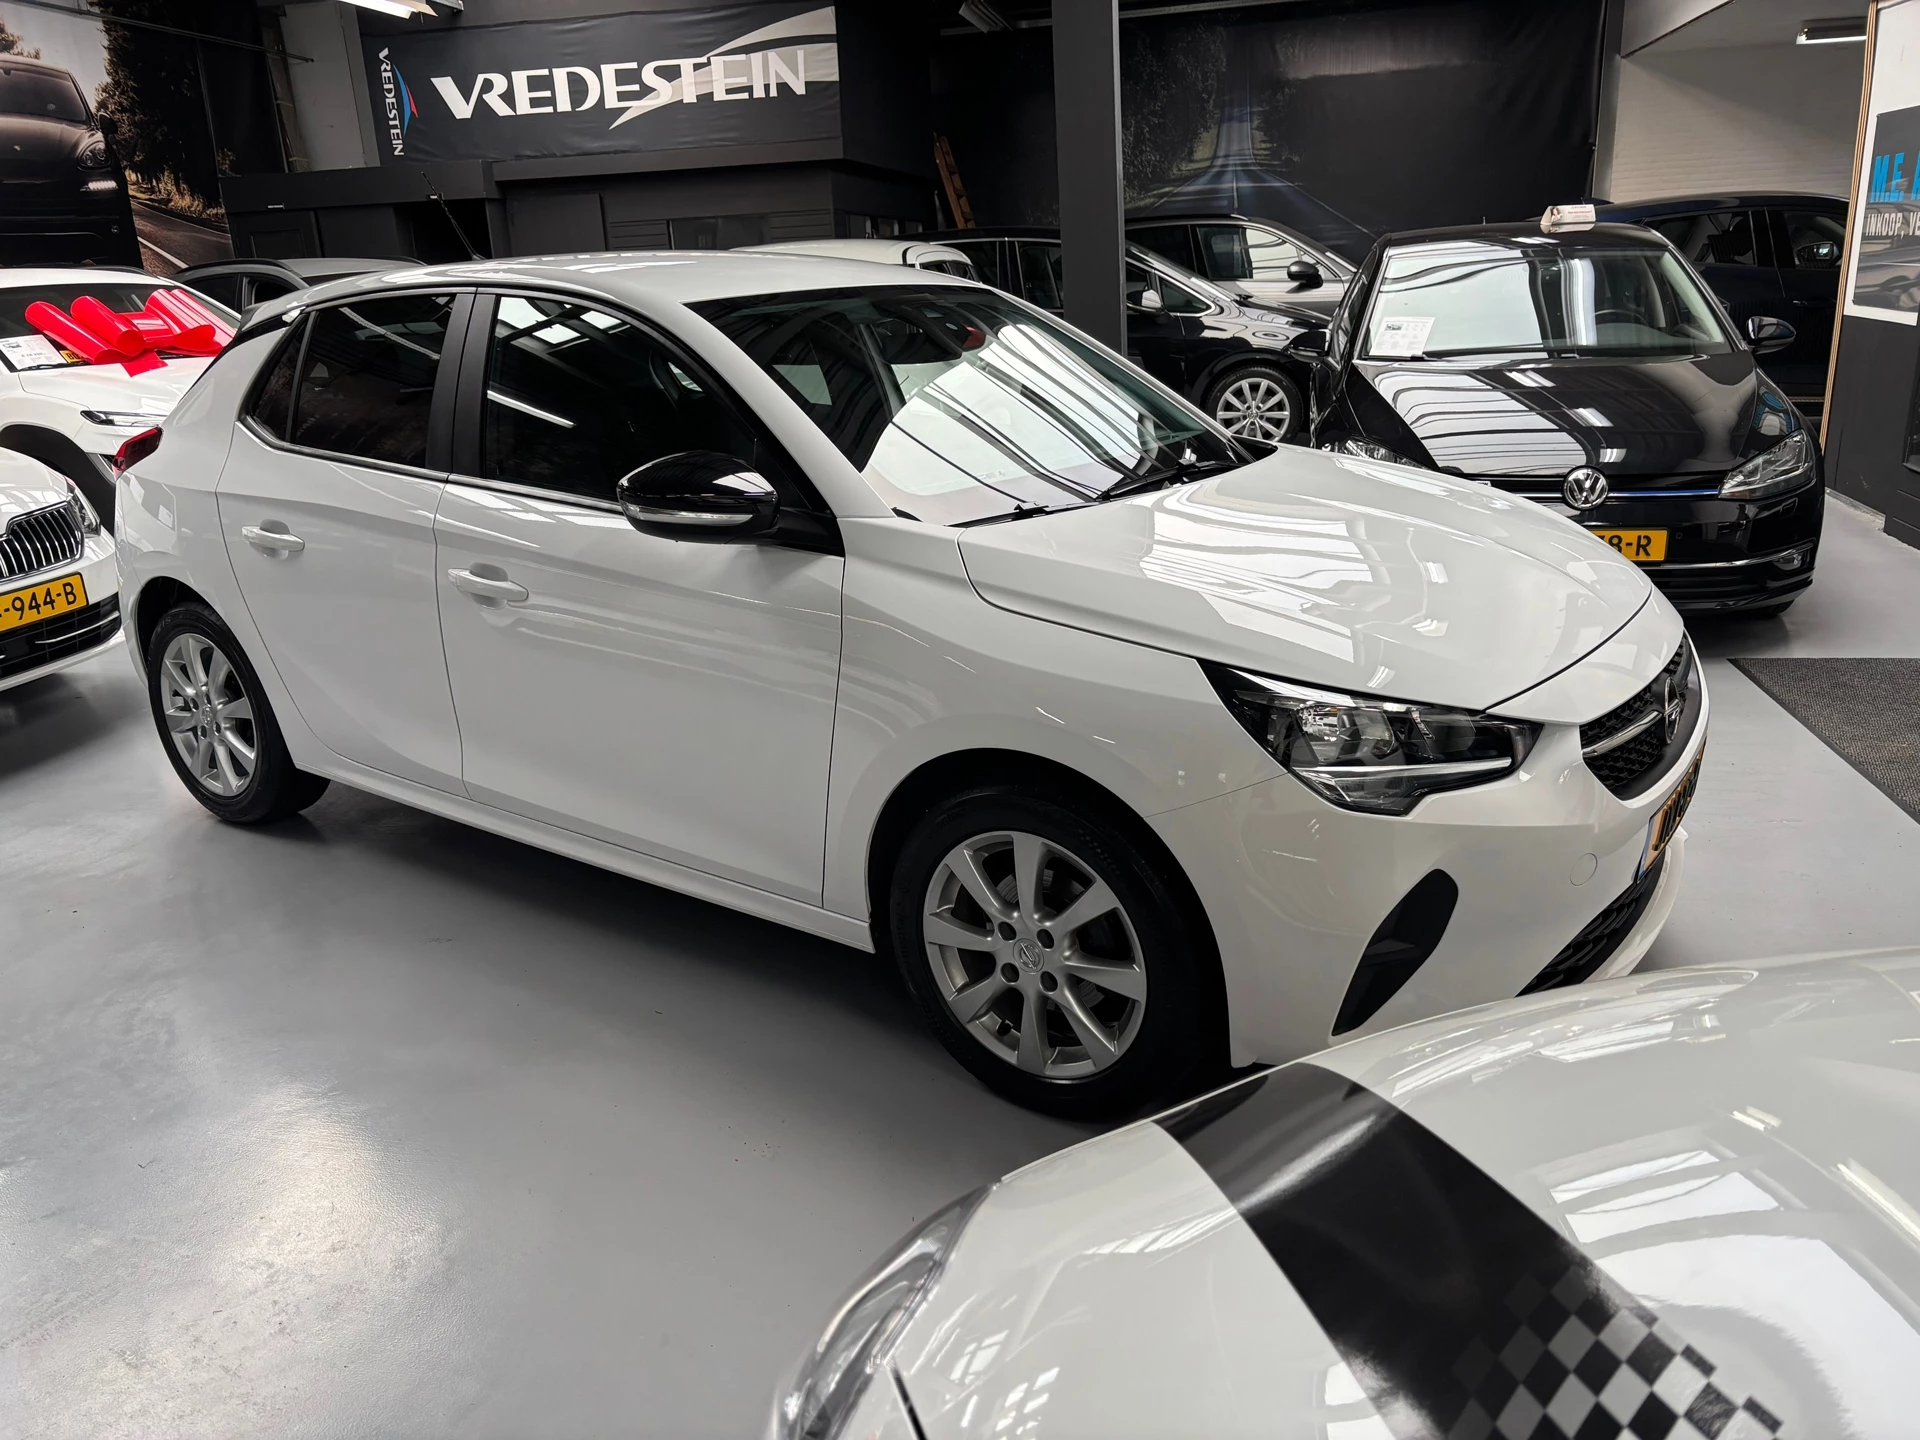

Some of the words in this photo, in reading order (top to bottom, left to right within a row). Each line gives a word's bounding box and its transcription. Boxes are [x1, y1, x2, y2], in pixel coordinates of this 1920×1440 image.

[379, 47, 404, 156] VREDESTEIN
[430, 50, 807, 121] VREDESTEIN
[1870, 152, 1905, 203] M.E.
[1866, 212, 1904, 239] INKOOP,
[0, 582, 77, 621] -944-B
